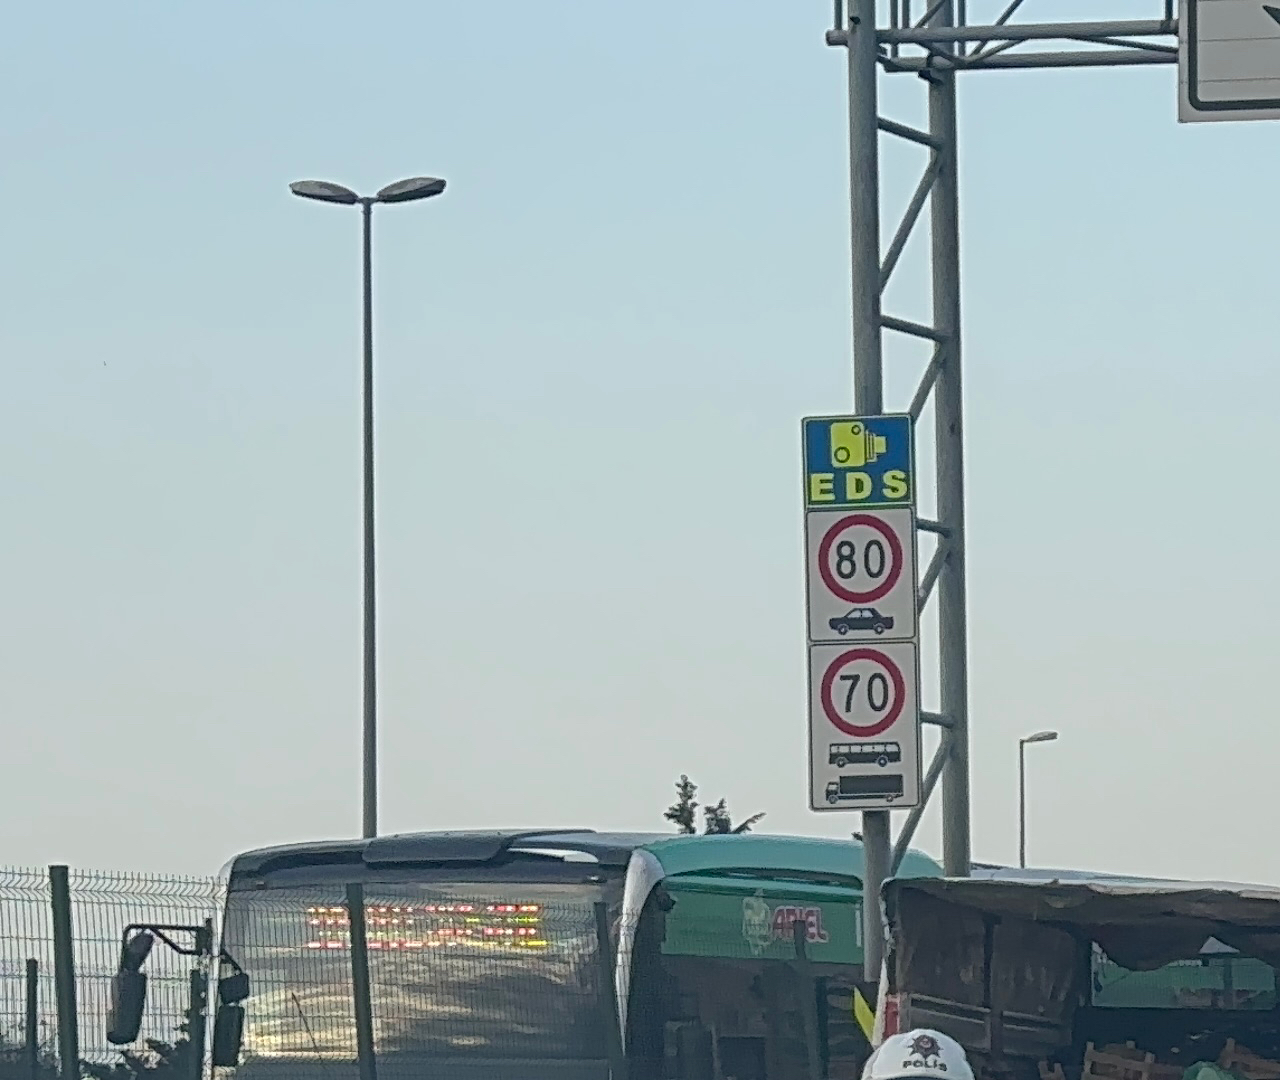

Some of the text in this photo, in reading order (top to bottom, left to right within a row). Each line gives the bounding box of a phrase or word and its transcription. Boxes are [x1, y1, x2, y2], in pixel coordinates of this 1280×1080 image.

[811, 470, 908, 501] EDS
[836, 539, 885, 580] 80
[839, 672, 889, 713] 70
